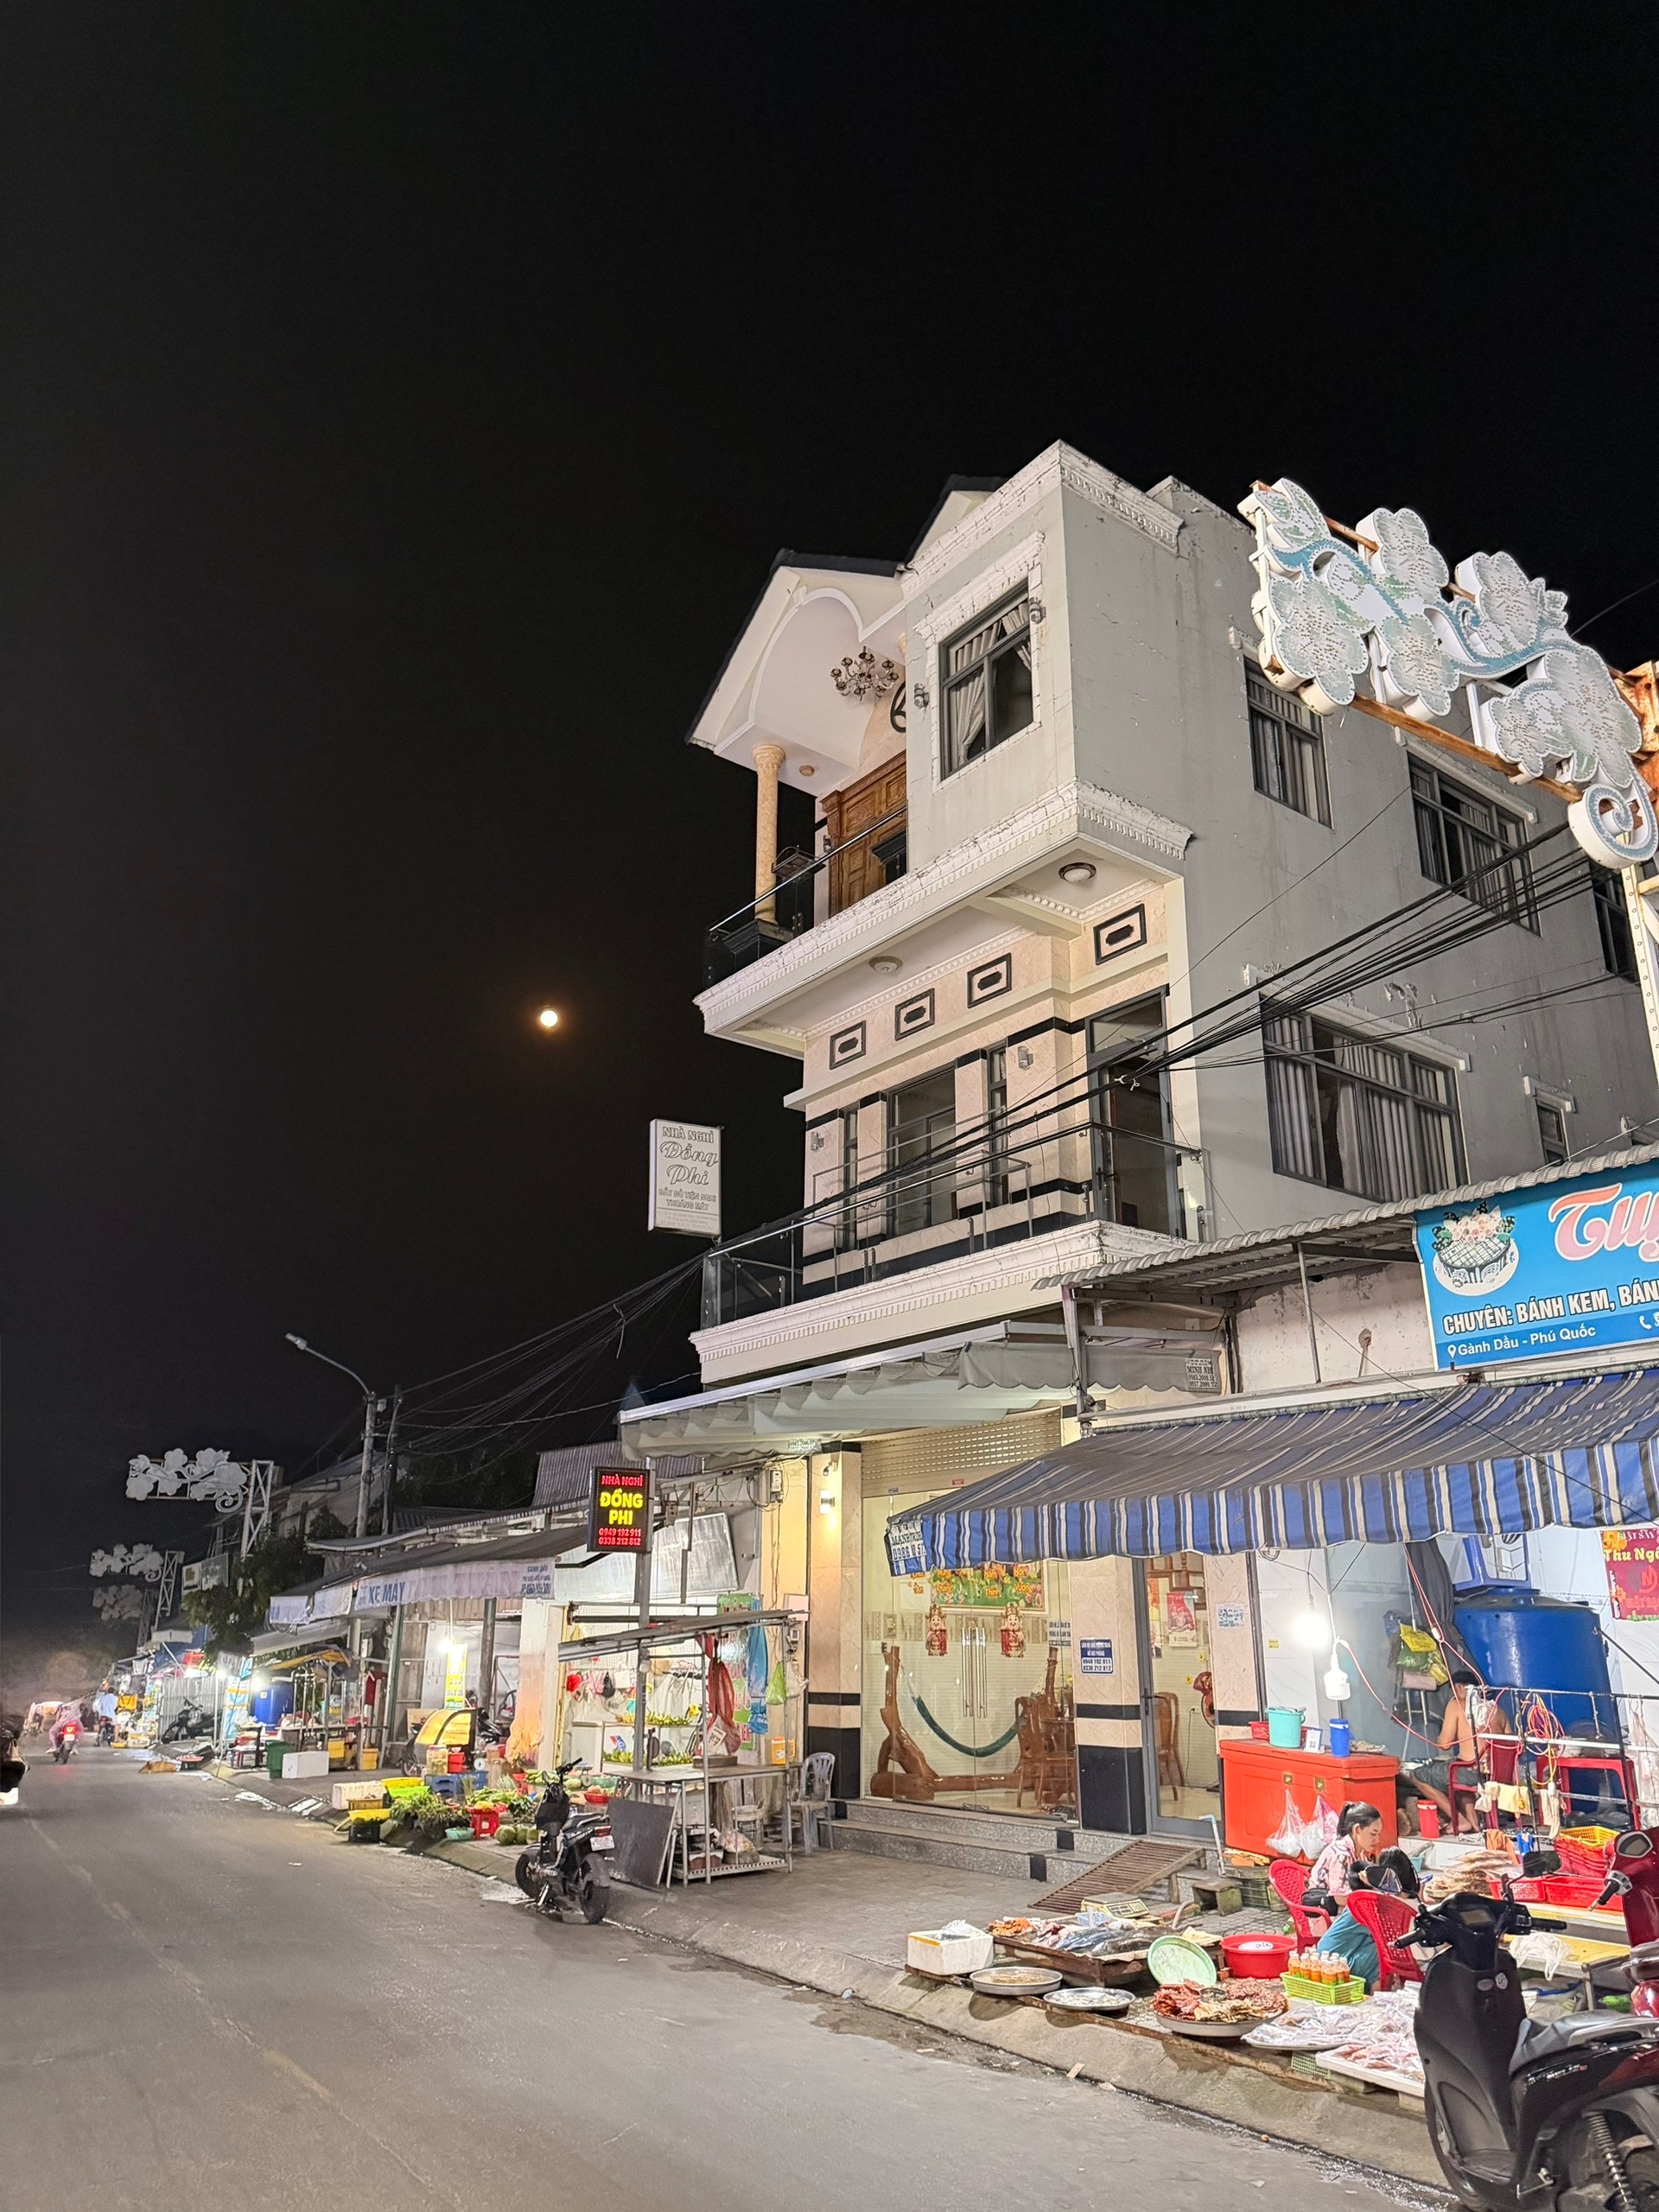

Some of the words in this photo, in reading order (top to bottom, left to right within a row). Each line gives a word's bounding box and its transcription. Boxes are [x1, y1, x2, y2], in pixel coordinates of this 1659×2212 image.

[662, 1126, 685, 1140] NHÀ
[666, 1164, 709, 1185] Phi
[1442, 1304, 1513, 1335] CHUYÊN:
[1516, 1296, 1566, 1325] BÁNH
[1567, 1287, 1616, 1315] KEM,
[1458, 1341, 1491, 1357] Gành
[1493, 1335, 1519, 1351] Dầu
[1529, 1329, 1556, 1346] Phú
[1559, 1323, 1597, 1340] Quốc
[601, 1473, 620, 1485] NHÀ
[621, 1474, 643, 1487] NGHỈ
[608, 1510, 633, 1525] PHI
[599, 1528, 617, 1536] 0949
[617, 1528, 629, 1536] 192
[629, 1528, 641, 1537] 911
[616, 1537, 629, 1546] 212
[628, 1537, 641, 1546] 812
[1604, 1548, 1631, 1562] Thu
[369, 1586, 381, 1605] XE
[382, 1579, 406, 1603] MÁY
